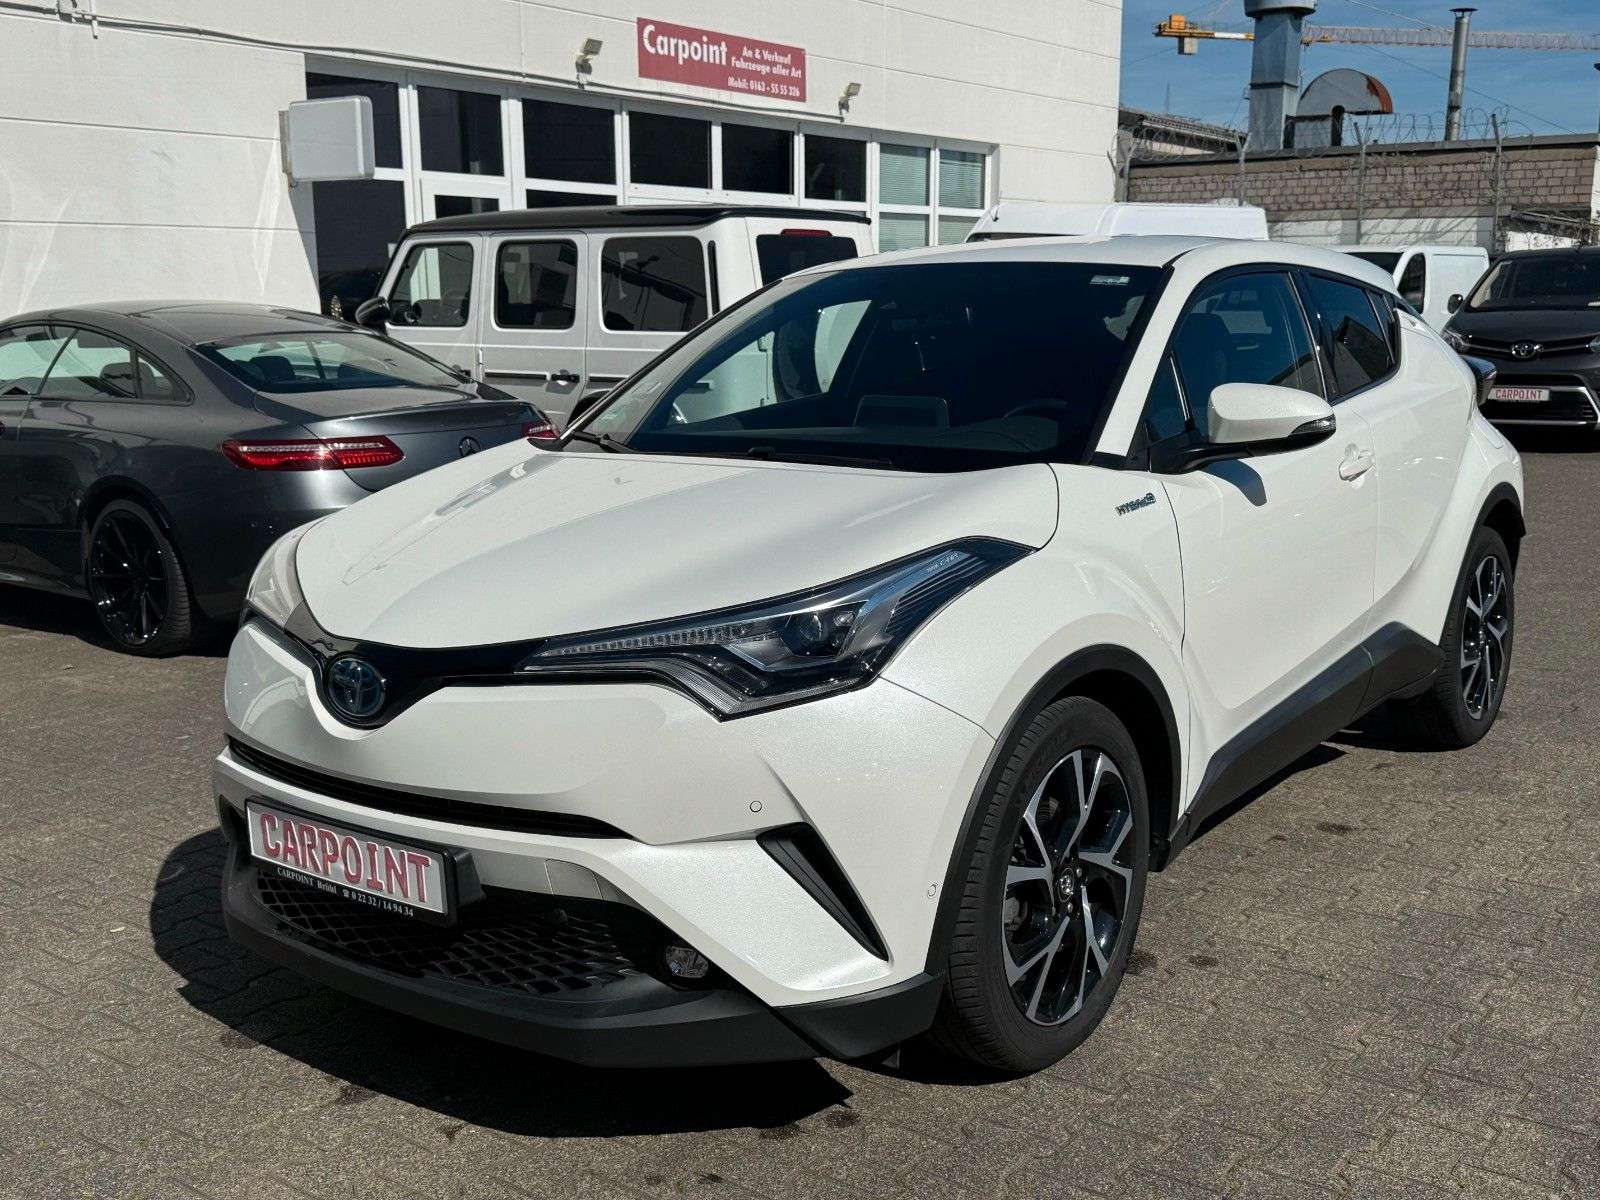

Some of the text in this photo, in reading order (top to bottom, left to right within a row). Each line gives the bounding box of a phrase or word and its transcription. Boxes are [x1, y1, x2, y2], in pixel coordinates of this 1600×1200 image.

[643, 25, 728, 65] Carpoint
[742, 46, 791, 65] An & Verkauf
[731, 56, 802, 78] Fahrzeuge aller Art
[1495, 389, 1543, 400] CARPOINT
[260, 813, 431, 903] CARPOINT
[277, 867, 315, 886] CARPOINT
[317, 880, 337, 894] Brühl
